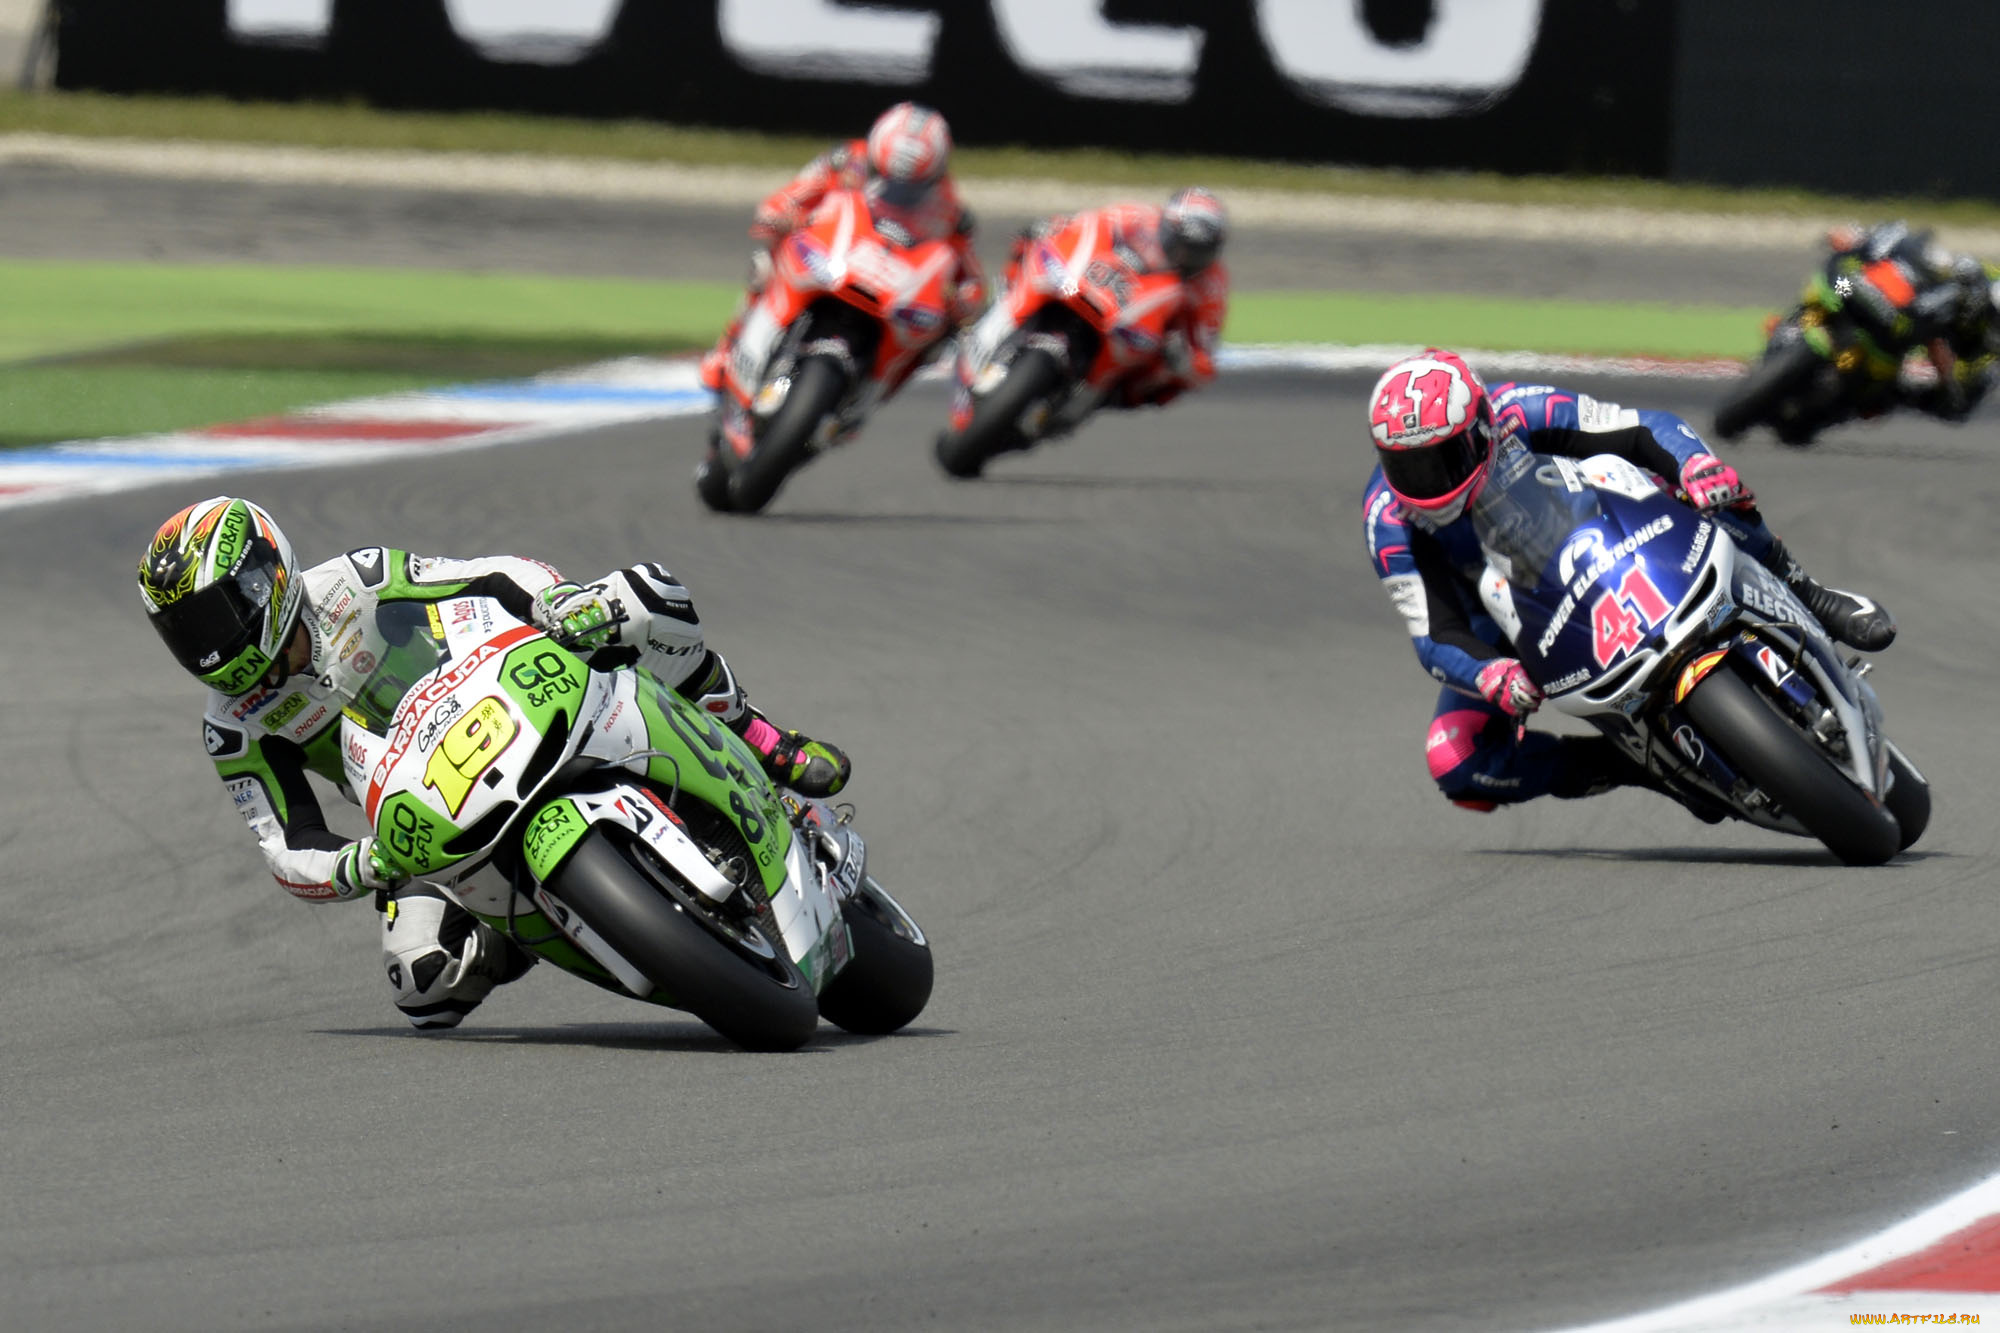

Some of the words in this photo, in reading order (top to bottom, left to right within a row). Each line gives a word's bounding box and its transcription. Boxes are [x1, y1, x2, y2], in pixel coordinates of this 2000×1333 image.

[215, 509, 247, 569] GO&FUN
[328, 593, 352, 624] Castrol
[1537, 591, 1576, 658] POWER
[1591, 564, 1676, 671] 41
[509, 651, 566, 690] GO
[527, 673, 580, 708] &FUN
[263, 692, 304, 727] GO&FUN
[294, 705, 328, 737] SHOWA
[373, 644, 500, 788] BARRACUDA
[395, 676, 434, 721] HONDA
[423, 695, 521, 820] 19
[389, 802, 417, 857] GO
[414, 817, 435, 869] &FUN
[525, 805, 565, 850] GO
